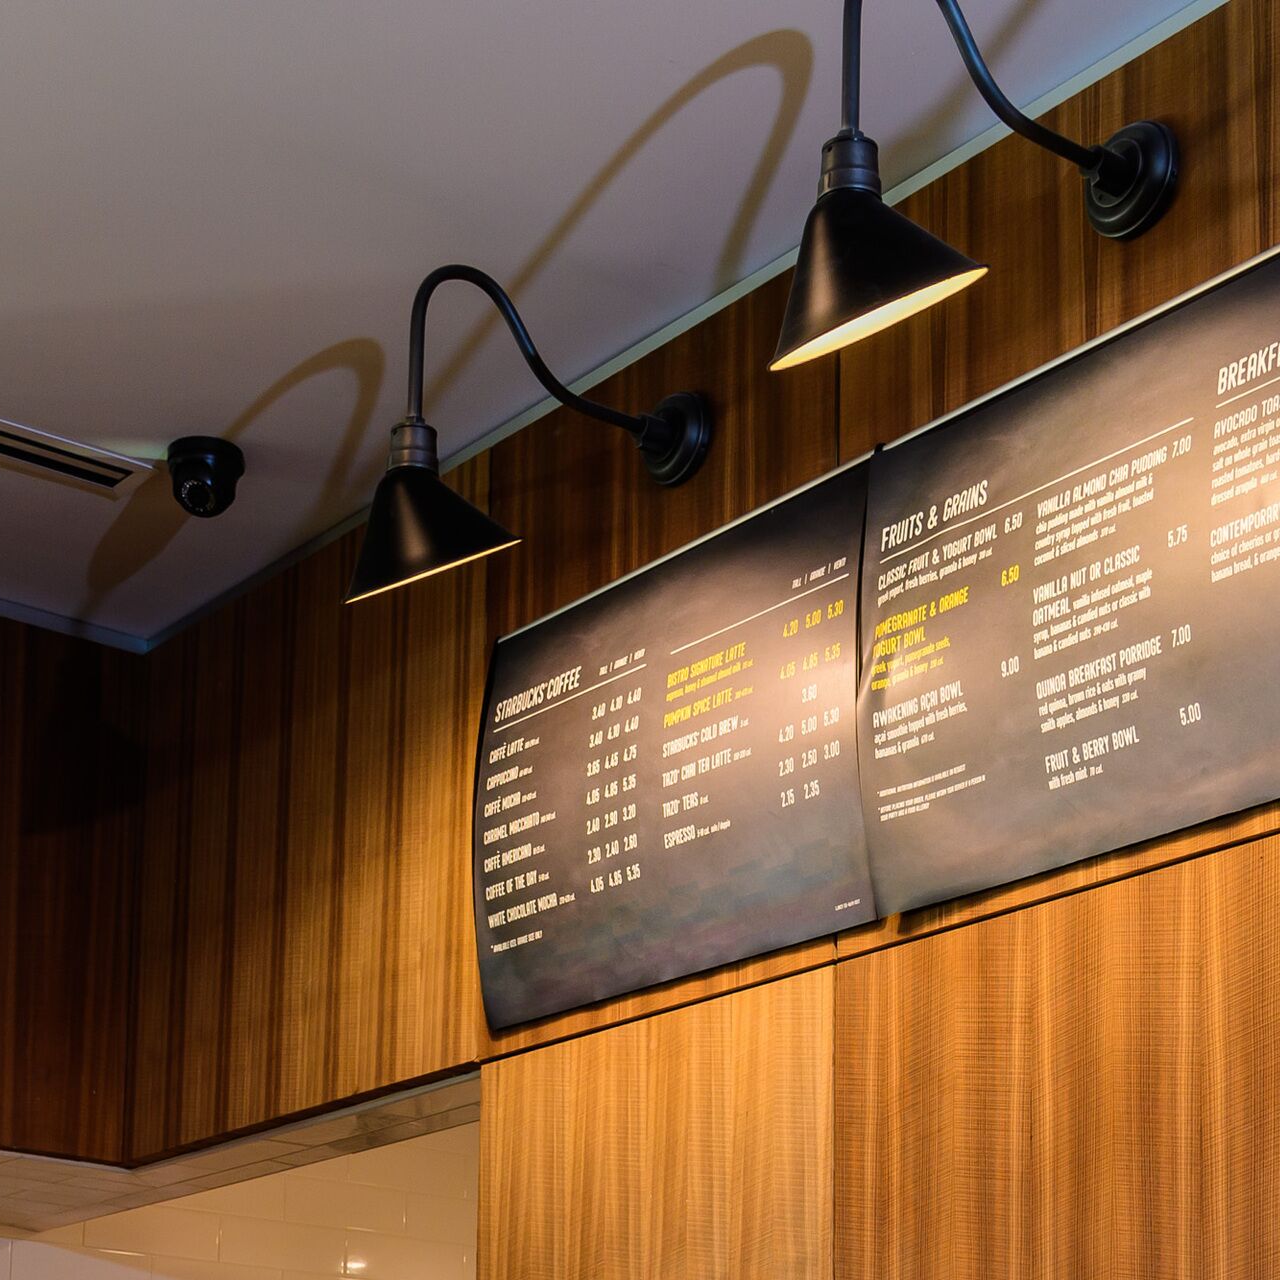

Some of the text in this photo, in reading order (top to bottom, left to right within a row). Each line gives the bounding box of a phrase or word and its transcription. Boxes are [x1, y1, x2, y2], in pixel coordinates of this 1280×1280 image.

[1213, 407, 1258, 439] AVOCADO
[881, 480, 988, 552] FRUITS & GRAINS
[547, 666, 582, 699] COFFEE
[1179, 702, 1201, 726] 5.00
[779, 740, 839, 776] 2.30 2.50 3.00
[1045, 725, 1140, 774] FRUIT & BERRY BOWL
[664, 824, 695, 849] ESPRESSO
